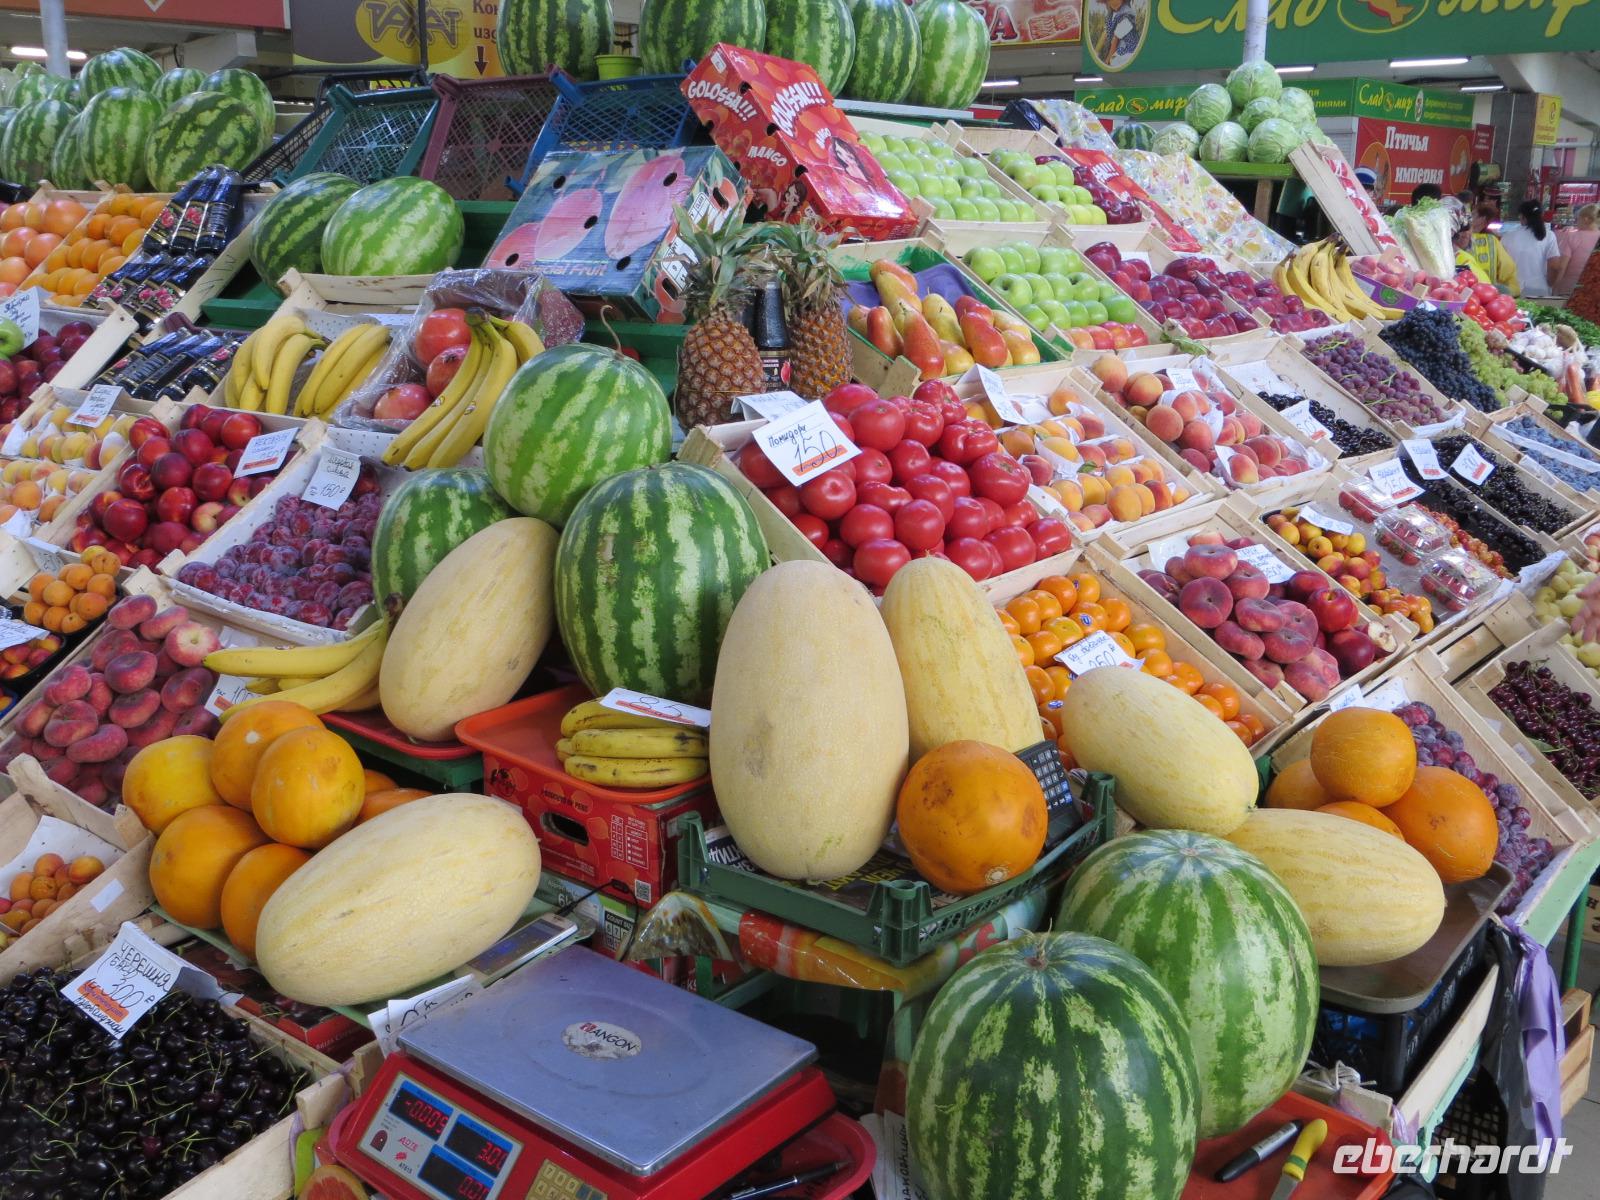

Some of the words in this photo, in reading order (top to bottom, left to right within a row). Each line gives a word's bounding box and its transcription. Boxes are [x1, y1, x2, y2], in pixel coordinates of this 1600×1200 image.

[687, 80, 758, 122] GOLOSSA!!!
[770, 81, 826, 138] GOLOSSA!!!
[1080, 95, 1125, 113] Слад
[1359, 83, 1385, 107] Слад
[1393, 95, 1414, 117] мир
[748, 144, 788, 168] MANGO
[1384, 126, 1430, 152] Птичья
[1394, 165, 1444, 185] империя
[794, 429, 838, 473] 150
[121, 942, 171, 992] ЧЕРЕШНЯ
